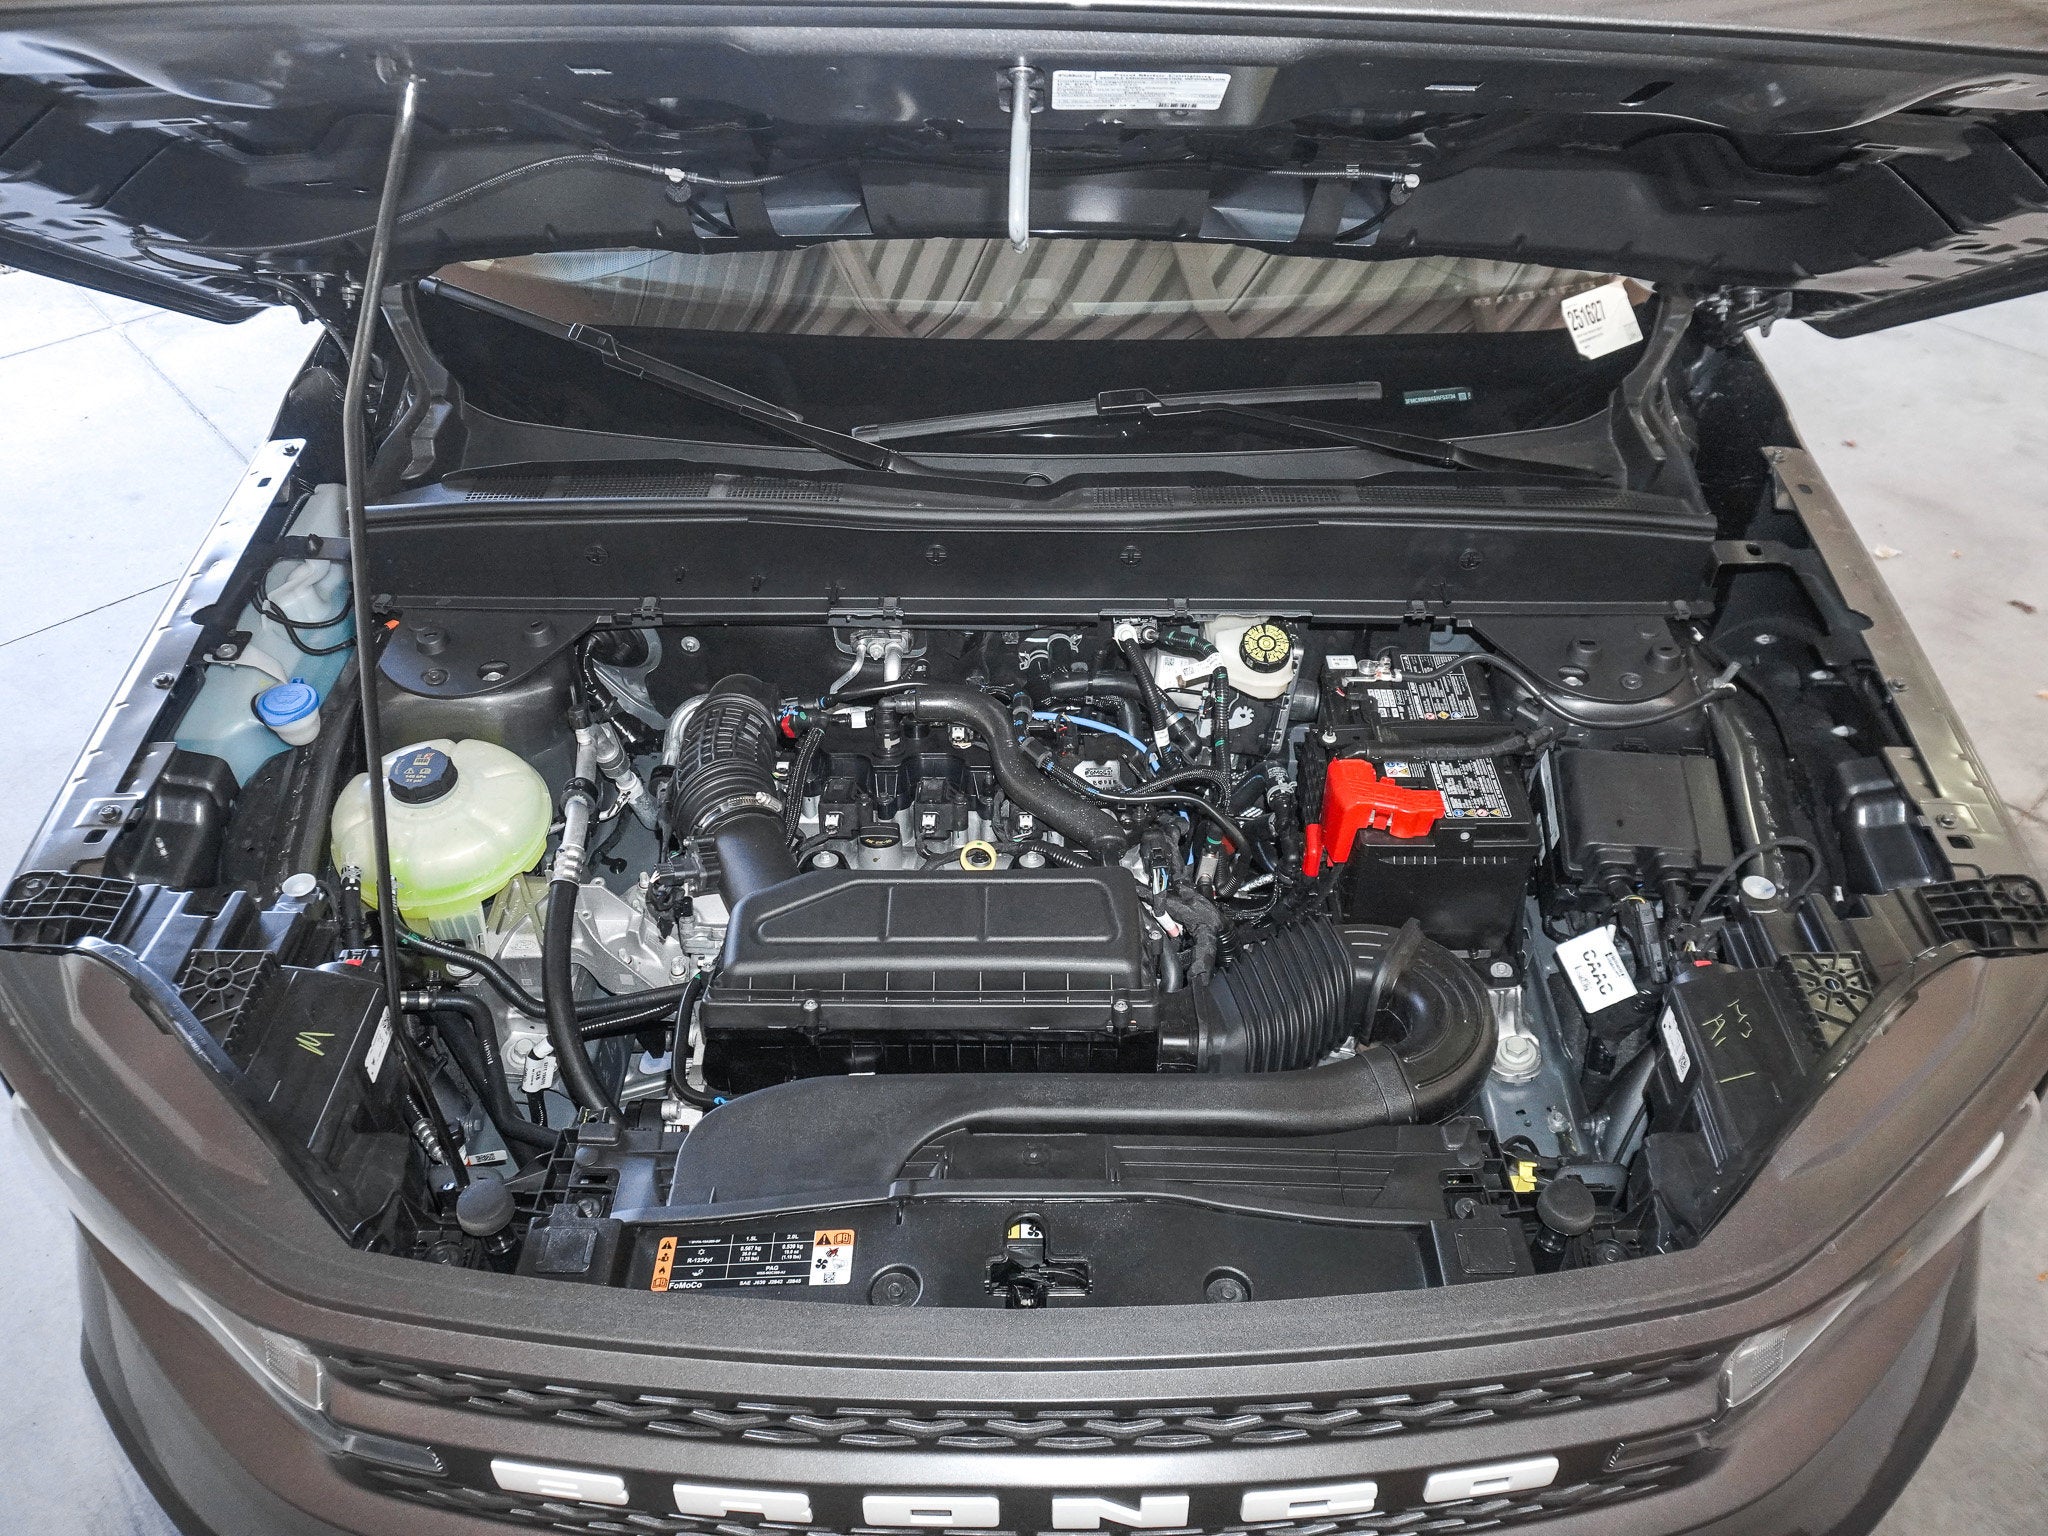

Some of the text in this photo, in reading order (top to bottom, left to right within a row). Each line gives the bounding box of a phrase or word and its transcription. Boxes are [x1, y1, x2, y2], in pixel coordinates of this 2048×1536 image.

[1567, 300, 1606, 331] 251627
[687, 1256, 714, 1264] R-1234yf
[668, 1280, 703, 1290] FoMoCo
